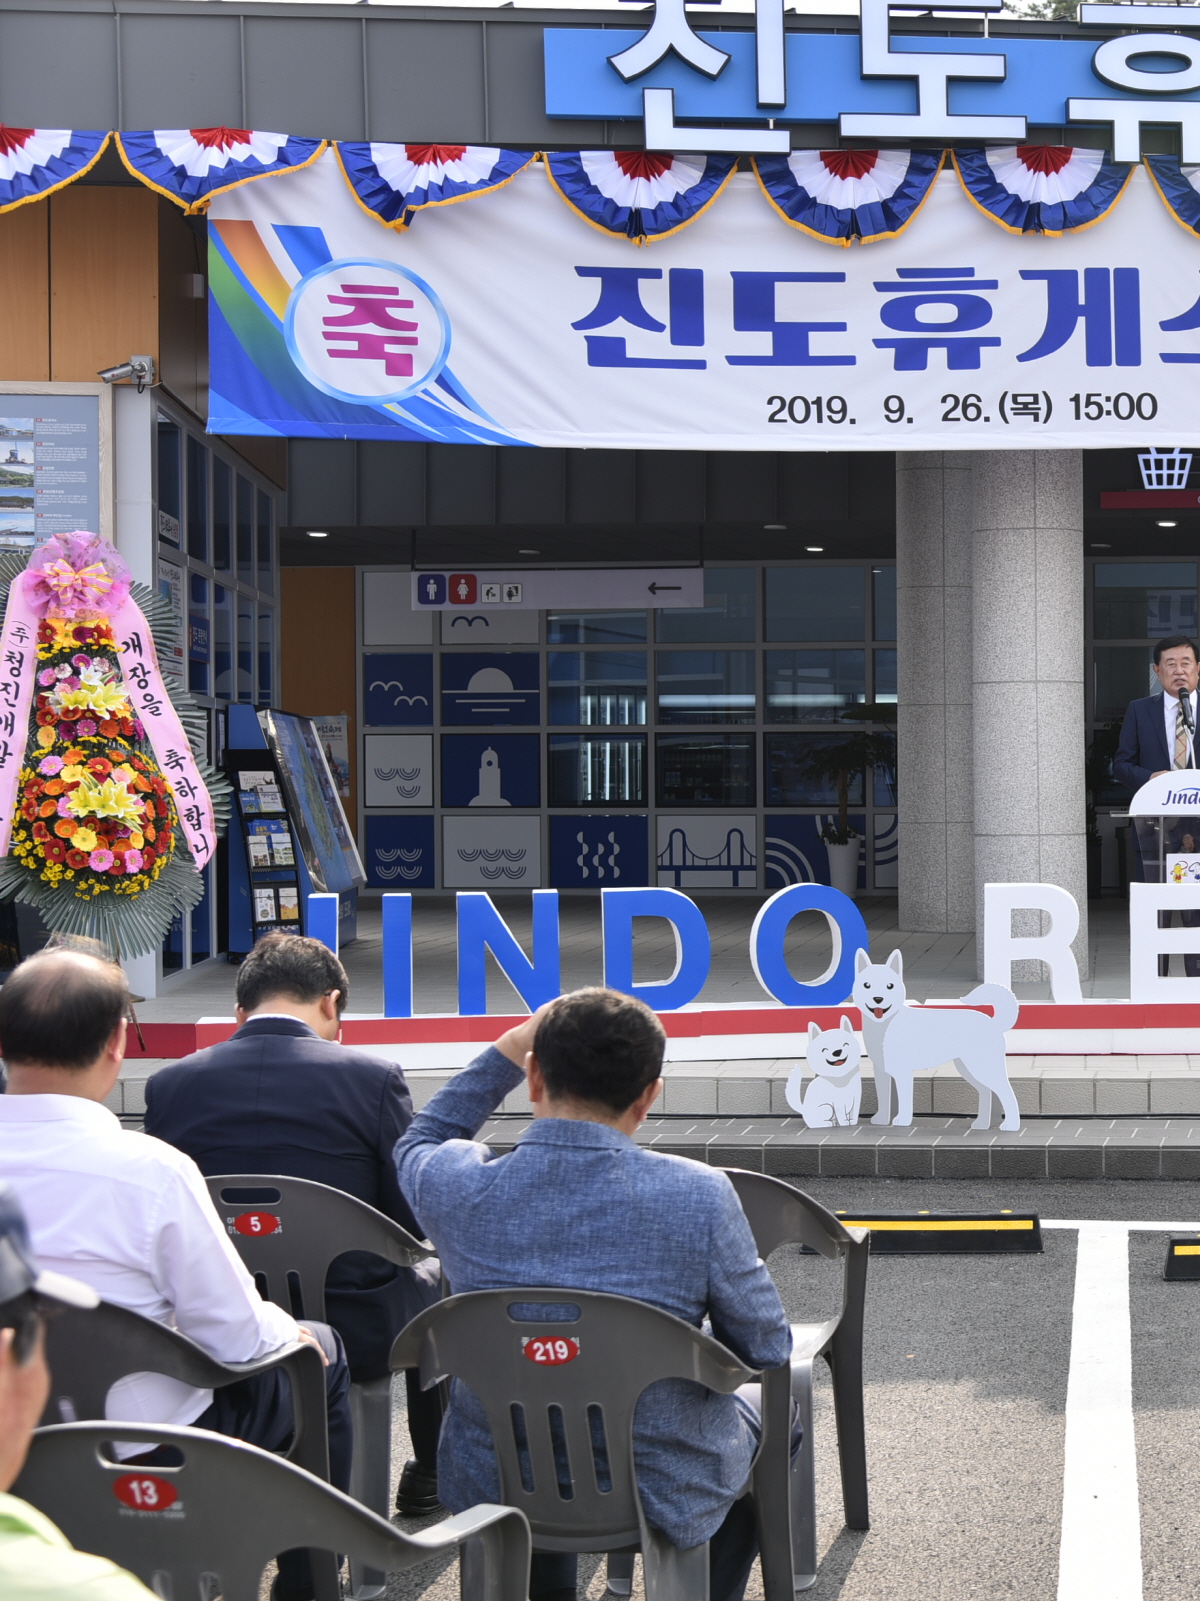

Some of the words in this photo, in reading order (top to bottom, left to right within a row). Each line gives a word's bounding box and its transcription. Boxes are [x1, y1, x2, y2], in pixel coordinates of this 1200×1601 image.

[322, 284, 419, 377] 축
[767, 395, 857, 425] 2019.
[884, 396, 914, 424] 9.
[1070, 392, 1158, 421] 15:00
[250, 1216, 262, 1232] 5
[533, 1340, 569, 1361] 219
[129, 1480, 159, 1506] 13
